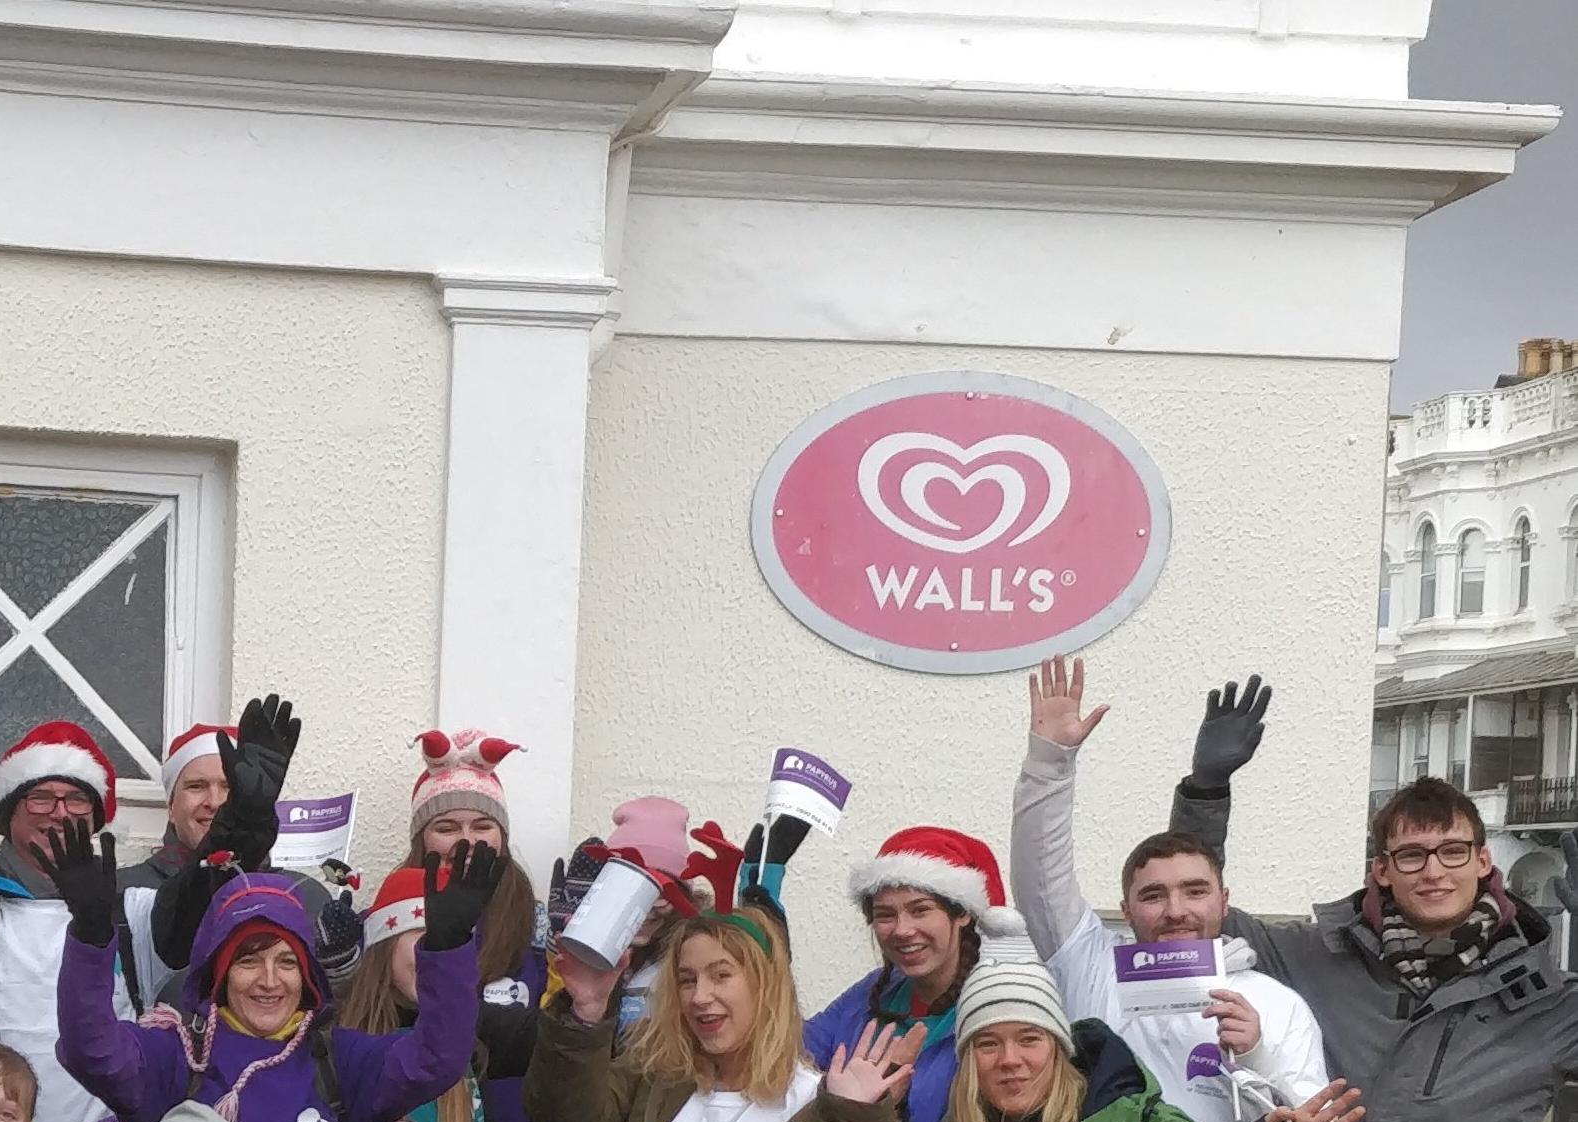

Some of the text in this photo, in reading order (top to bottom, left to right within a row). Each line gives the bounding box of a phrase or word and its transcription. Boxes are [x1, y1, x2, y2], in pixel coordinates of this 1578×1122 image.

[865, 564, 1055, 613] WALL'S
[804, 763, 838, 791] PAPYRUS
[311, 804, 343, 817] PAPYRUS
[1156, 950, 1199, 961] PAPYRUS
